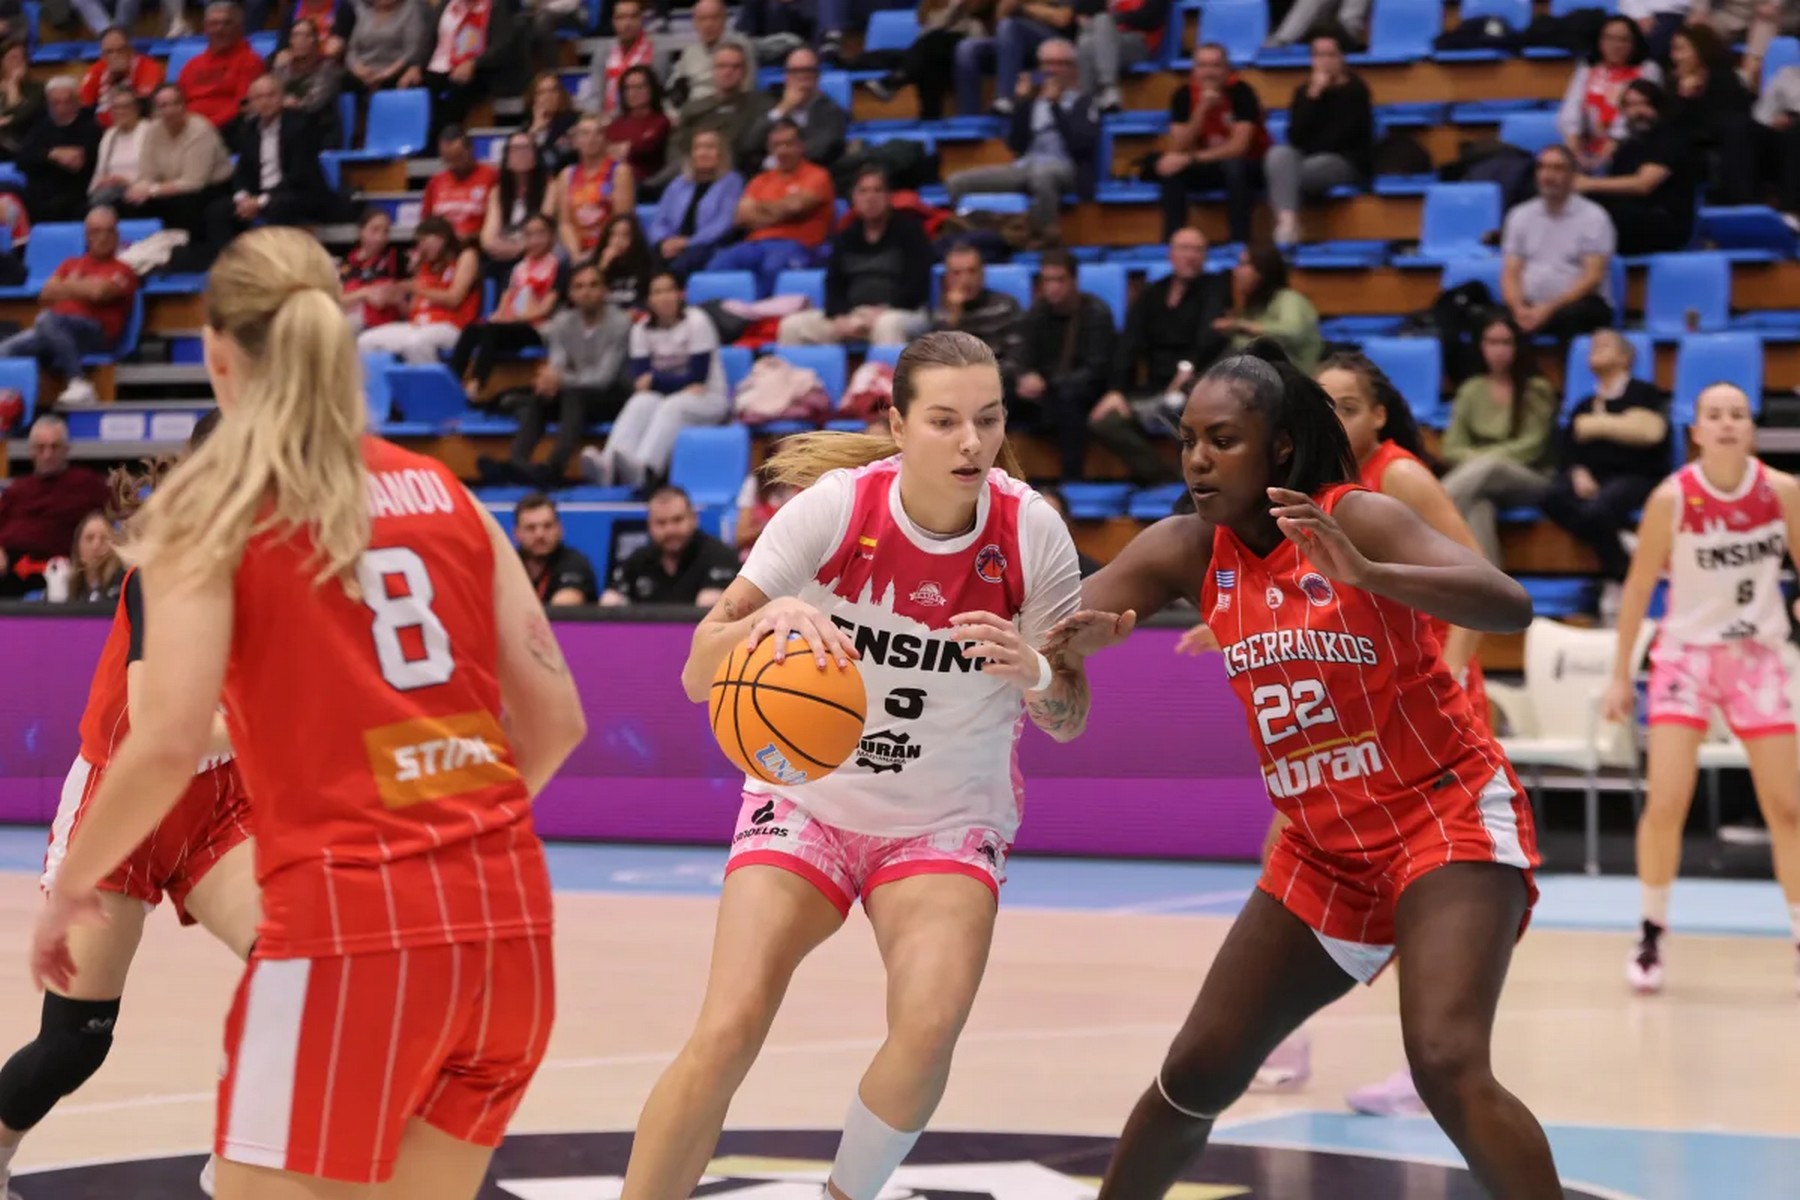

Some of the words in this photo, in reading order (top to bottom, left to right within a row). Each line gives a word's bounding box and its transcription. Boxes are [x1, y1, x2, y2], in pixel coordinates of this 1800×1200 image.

[355, 546, 456, 692] 8
[831, 614, 996, 673] NSIN
[1253, 678, 1336, 745] 22
[857, 738, 922, 759] URAN
